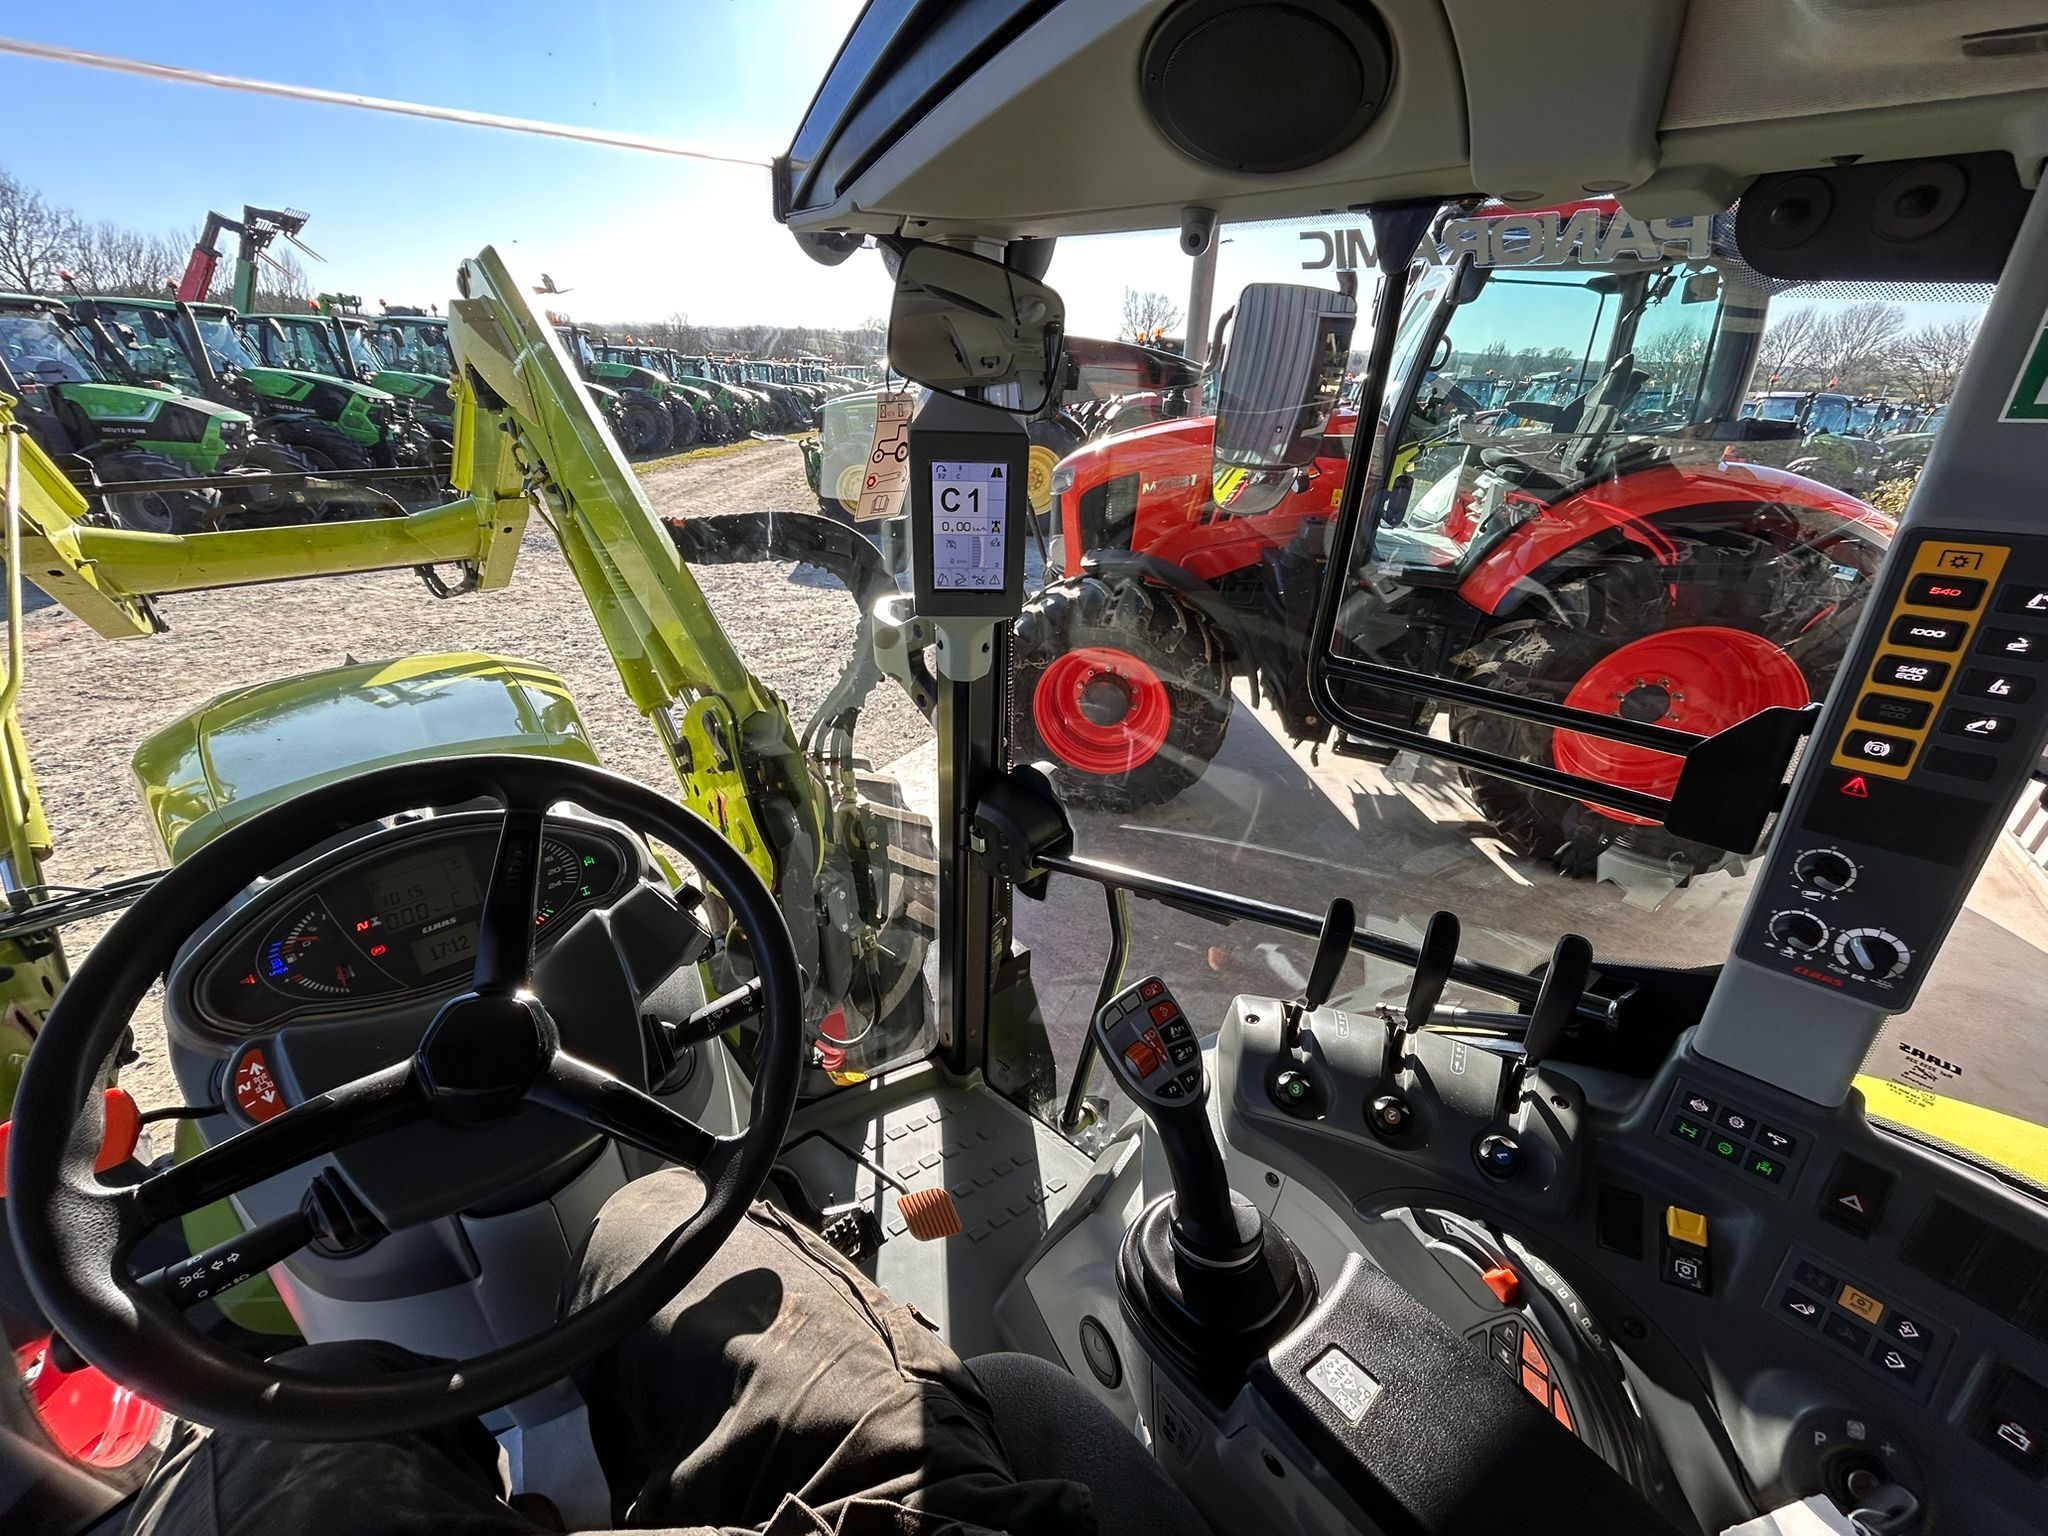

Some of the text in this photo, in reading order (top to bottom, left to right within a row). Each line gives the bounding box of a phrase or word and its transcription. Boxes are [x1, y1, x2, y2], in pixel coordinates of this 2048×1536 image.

[1928, 586, 1962, 598] 540
[1910, 627, 1947, 639] 1000
[1896, 665, 1928, 675] 540
[421, 916, 457, 934] CLAAS
[428, 935, 471, 961] 17:12
[1792, 965, 1844, 988] CLAAS
[1814, 1431, 1828, 1446] P
